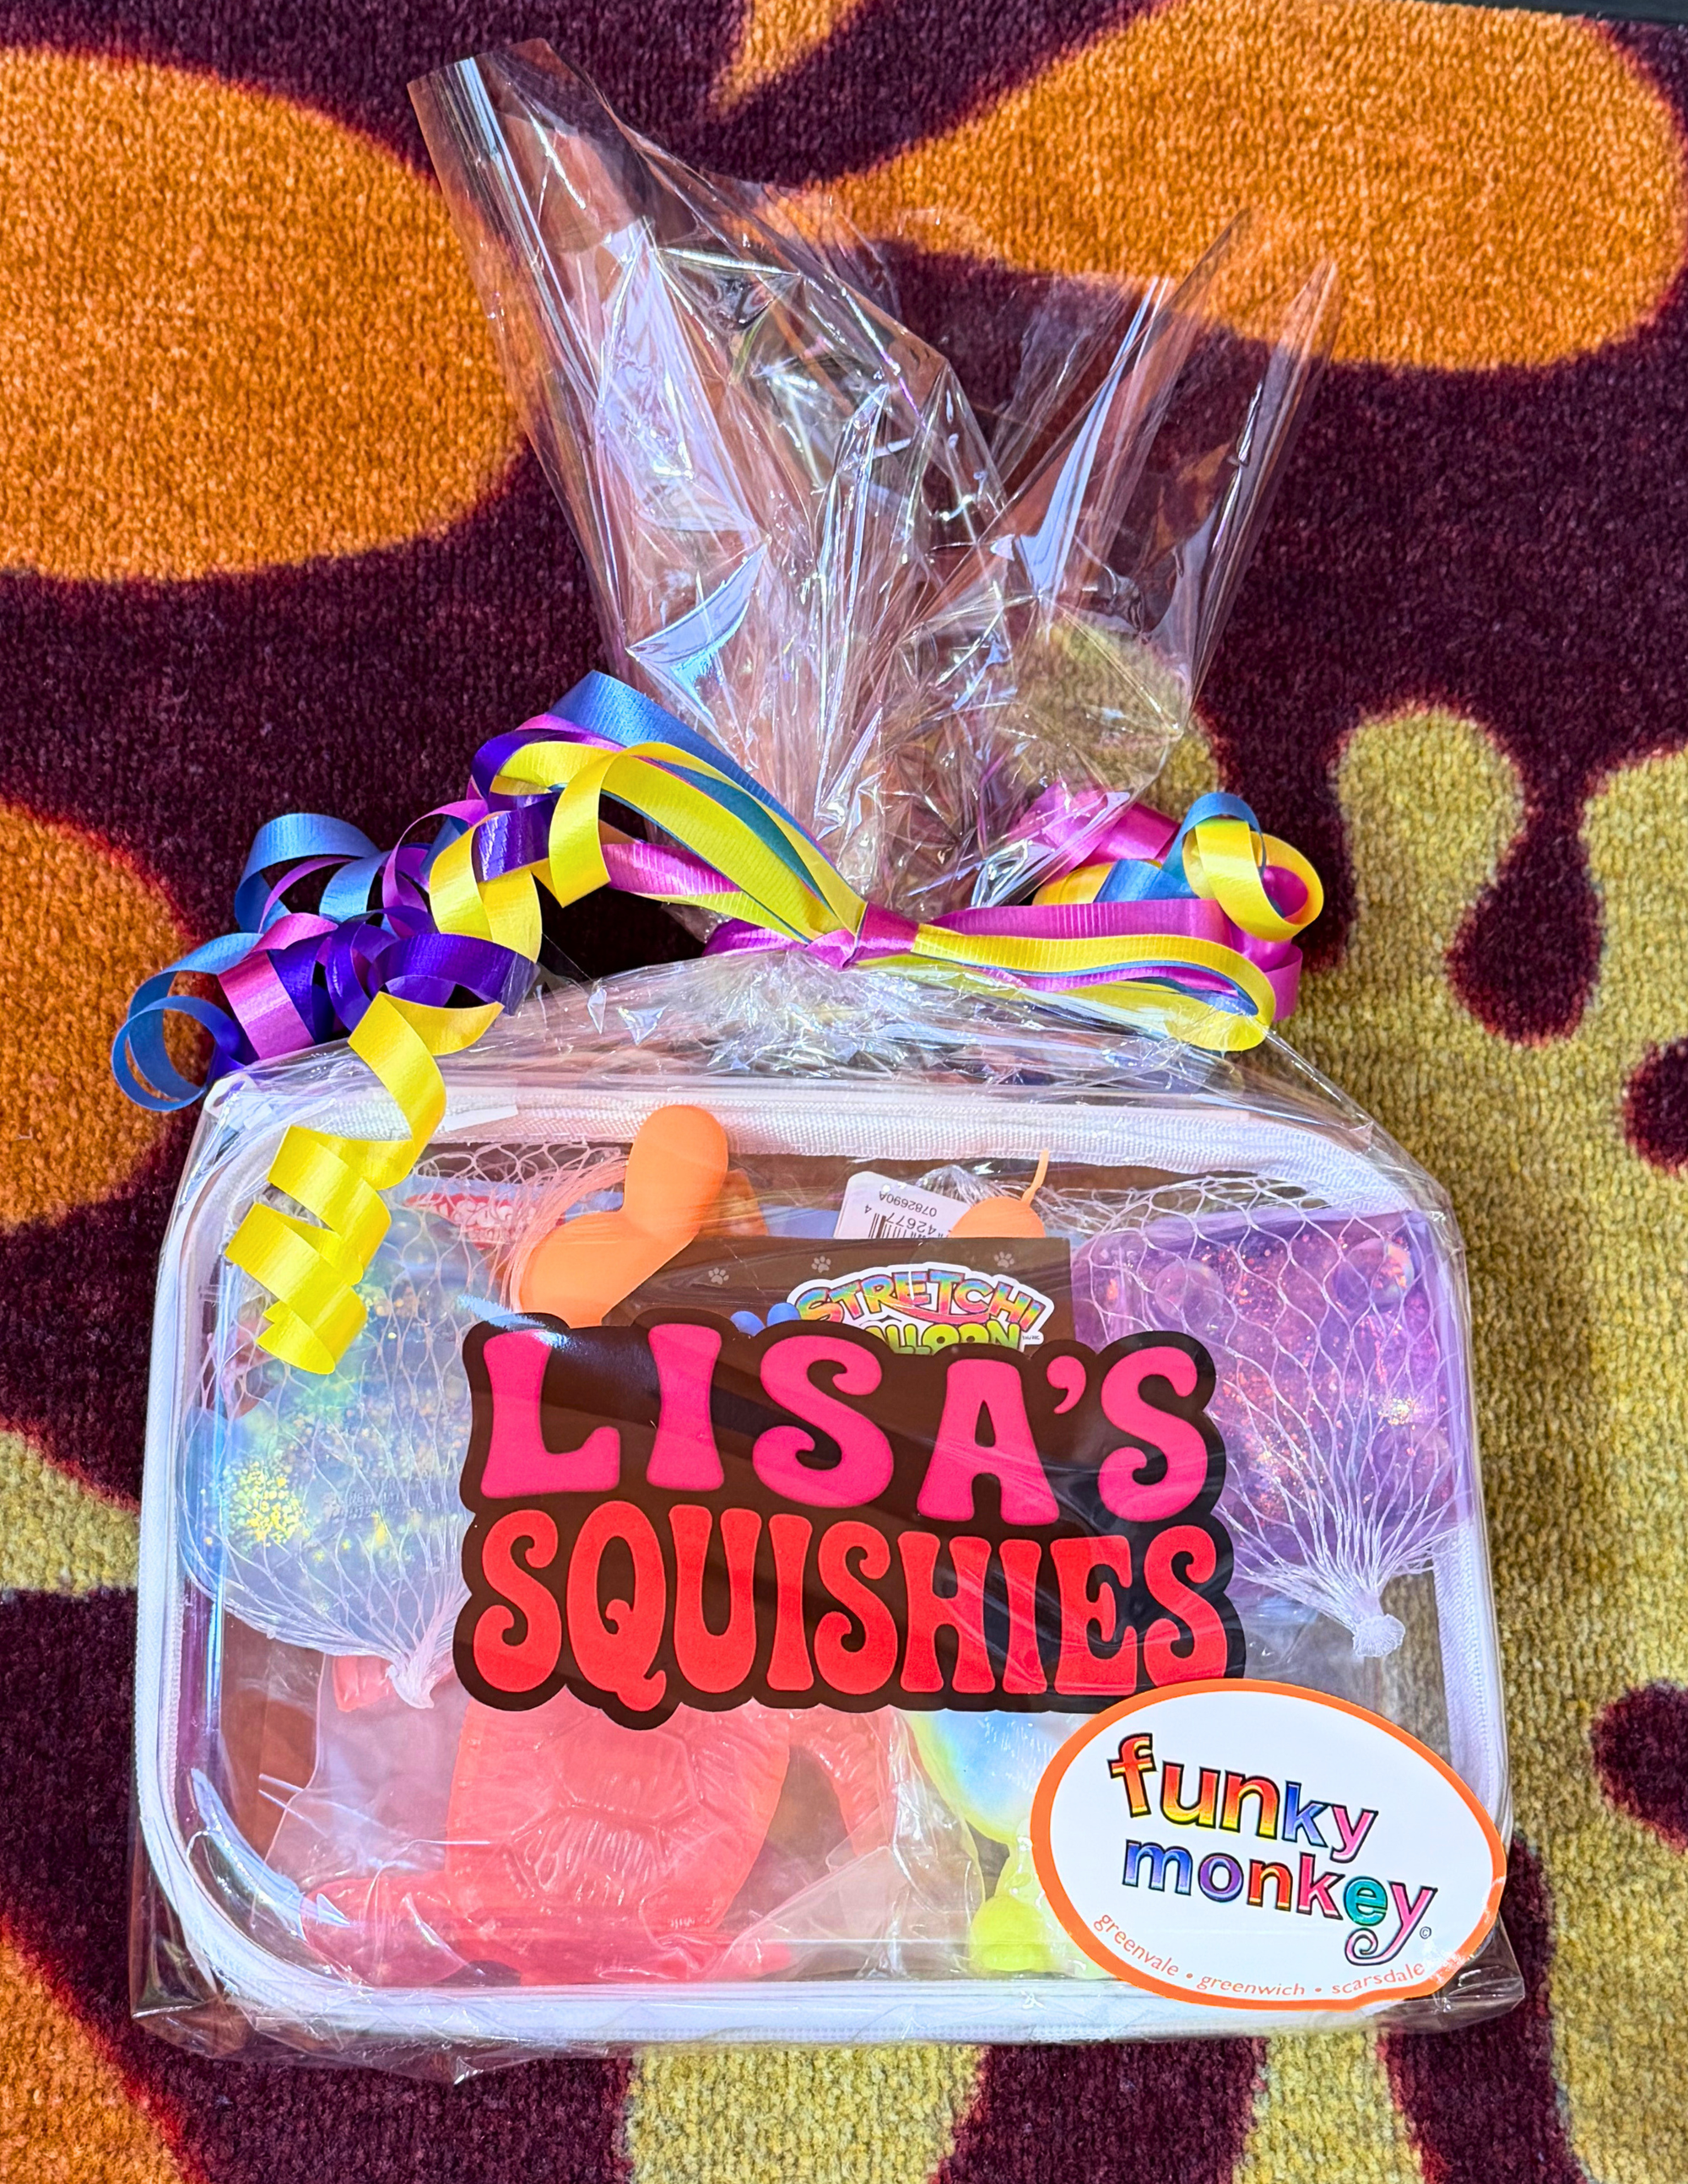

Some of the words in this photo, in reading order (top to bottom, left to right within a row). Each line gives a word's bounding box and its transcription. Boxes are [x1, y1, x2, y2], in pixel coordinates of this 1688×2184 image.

[879, 1191, 938, 1218] 0782690A
[795, 1269, 1047, 1332] STRETCHI
[864, 1319, 1021, 1355] ALLOON
[480, 1323, 1208, 1526] LISA'S
[473, 1500, 1229, 1712] SQUISHIES
[1106, 1733, 1378, 1864] funky
[1093, 1913, 1180, 1977] greenvale
[1197, 1975, 1306, 1996] greenwich
[1331, 1962, 1426, 1995] scarsdale
[1122, 1839, 1438, 1966] monkey
